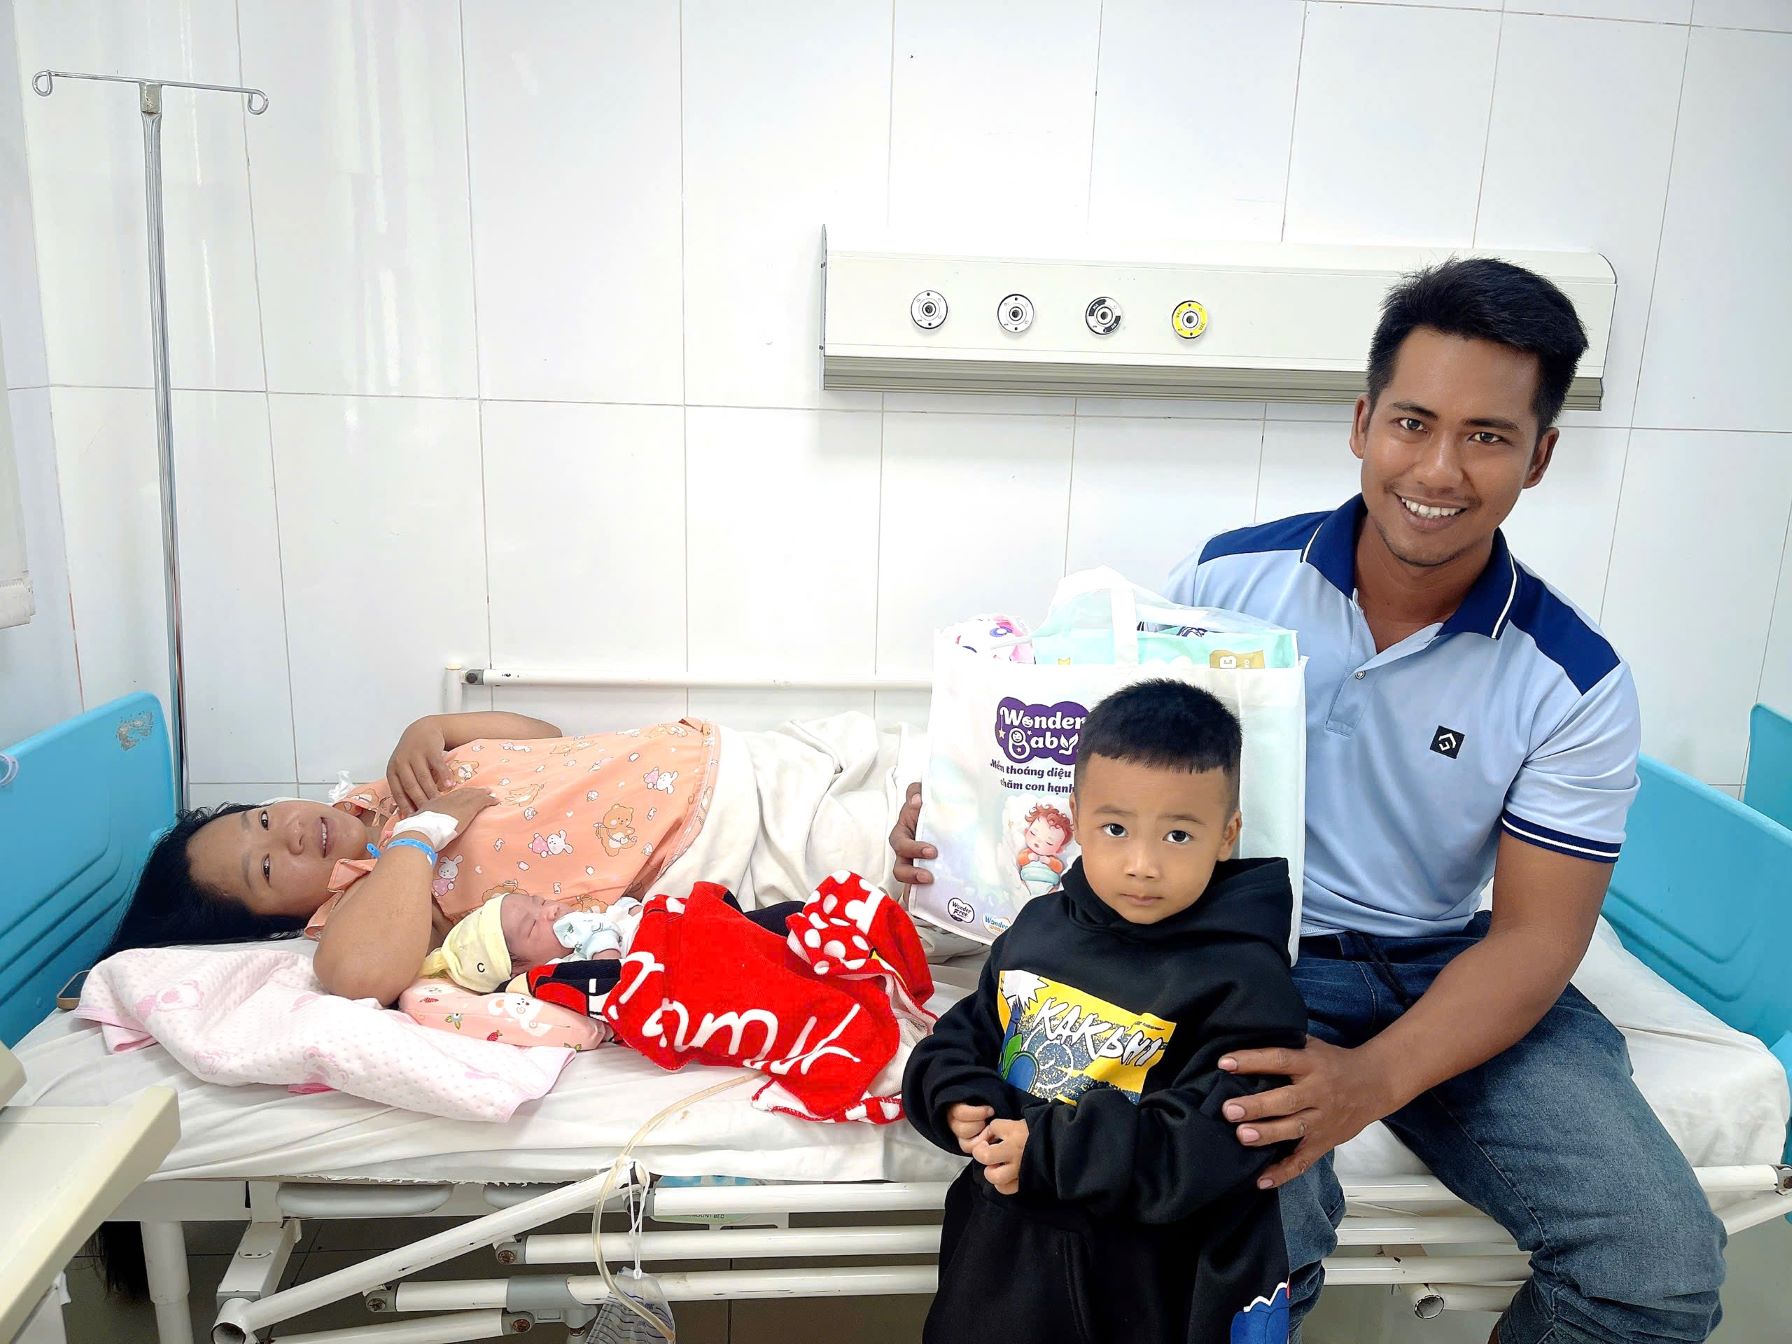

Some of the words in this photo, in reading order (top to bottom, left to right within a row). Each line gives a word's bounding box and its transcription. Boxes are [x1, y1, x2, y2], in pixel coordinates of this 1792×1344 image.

[1000, 706, 1086, 730] Wonder
[1008, 727, 1079, 760] Baby
[1006, 765, 1045, 779] thoáng
[1046, 767, 1072, 780] diệu
[1025, 784, 1045, 792] con
